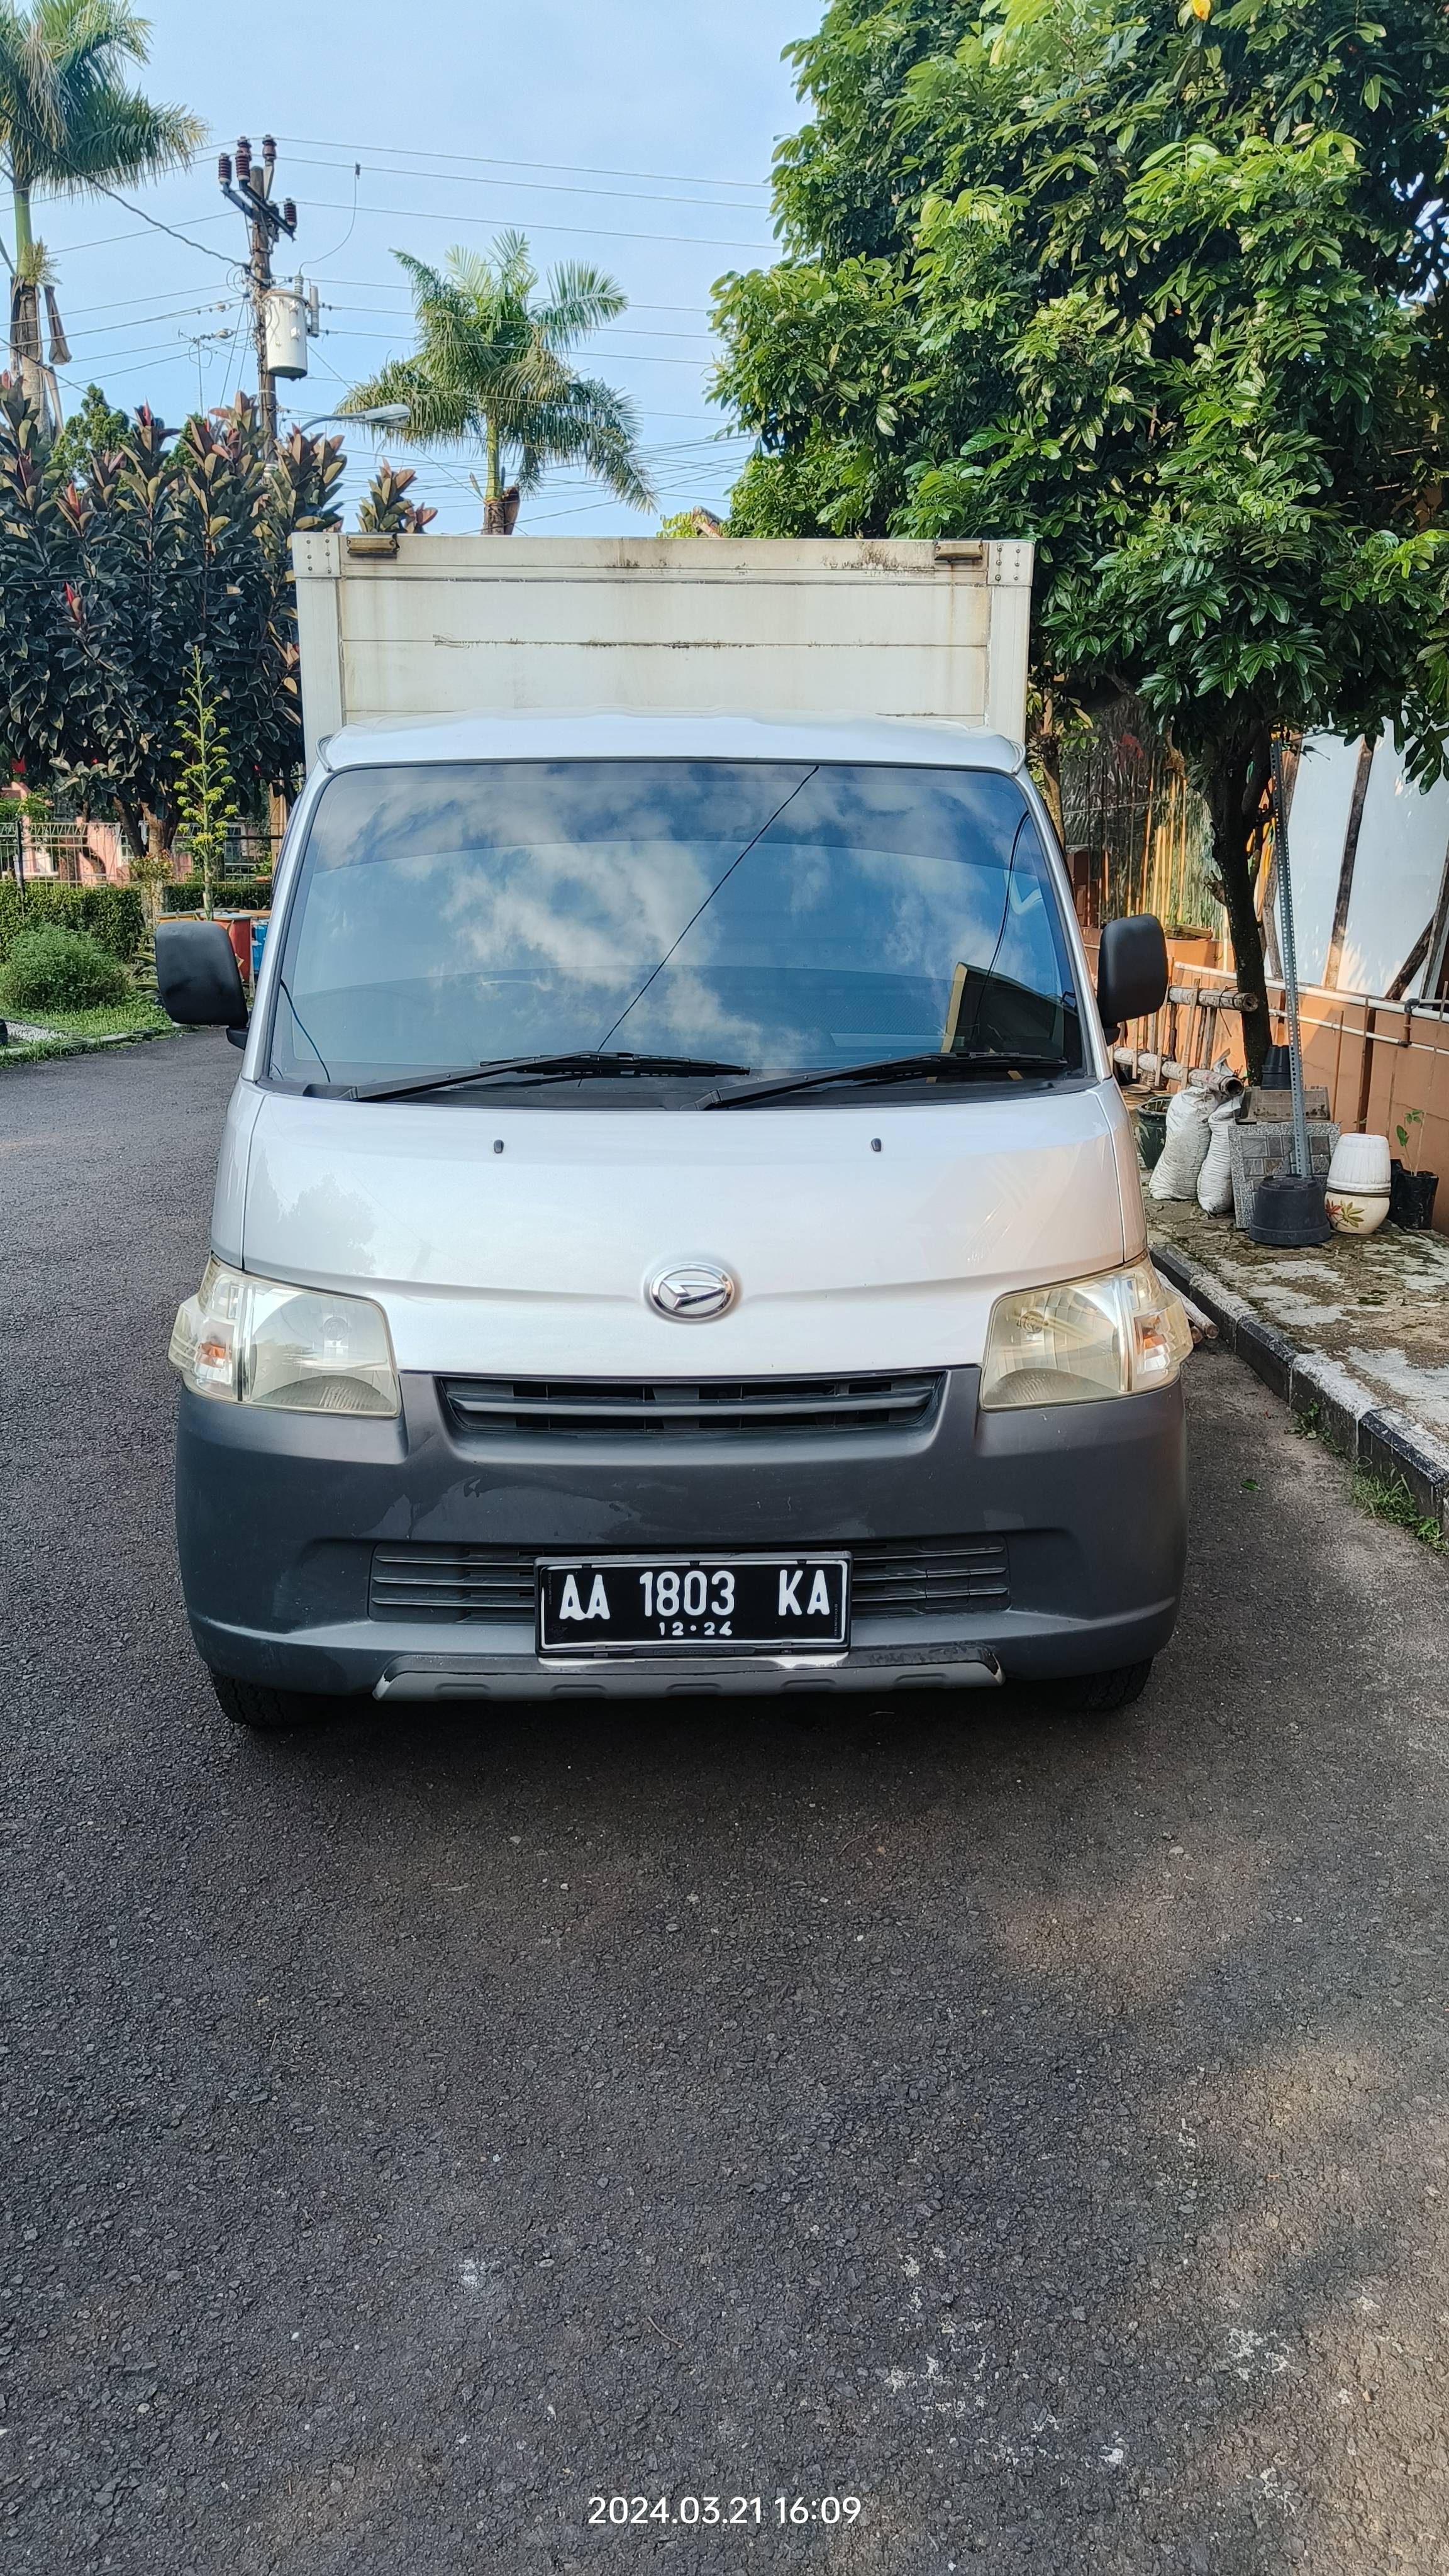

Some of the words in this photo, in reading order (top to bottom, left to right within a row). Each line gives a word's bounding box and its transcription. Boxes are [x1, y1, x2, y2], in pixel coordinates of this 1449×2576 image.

[559, 1574, 611, 1621] AA
[640, 1570, 735, 1617] 1803
[778, 1569, 830, 1616] KA
